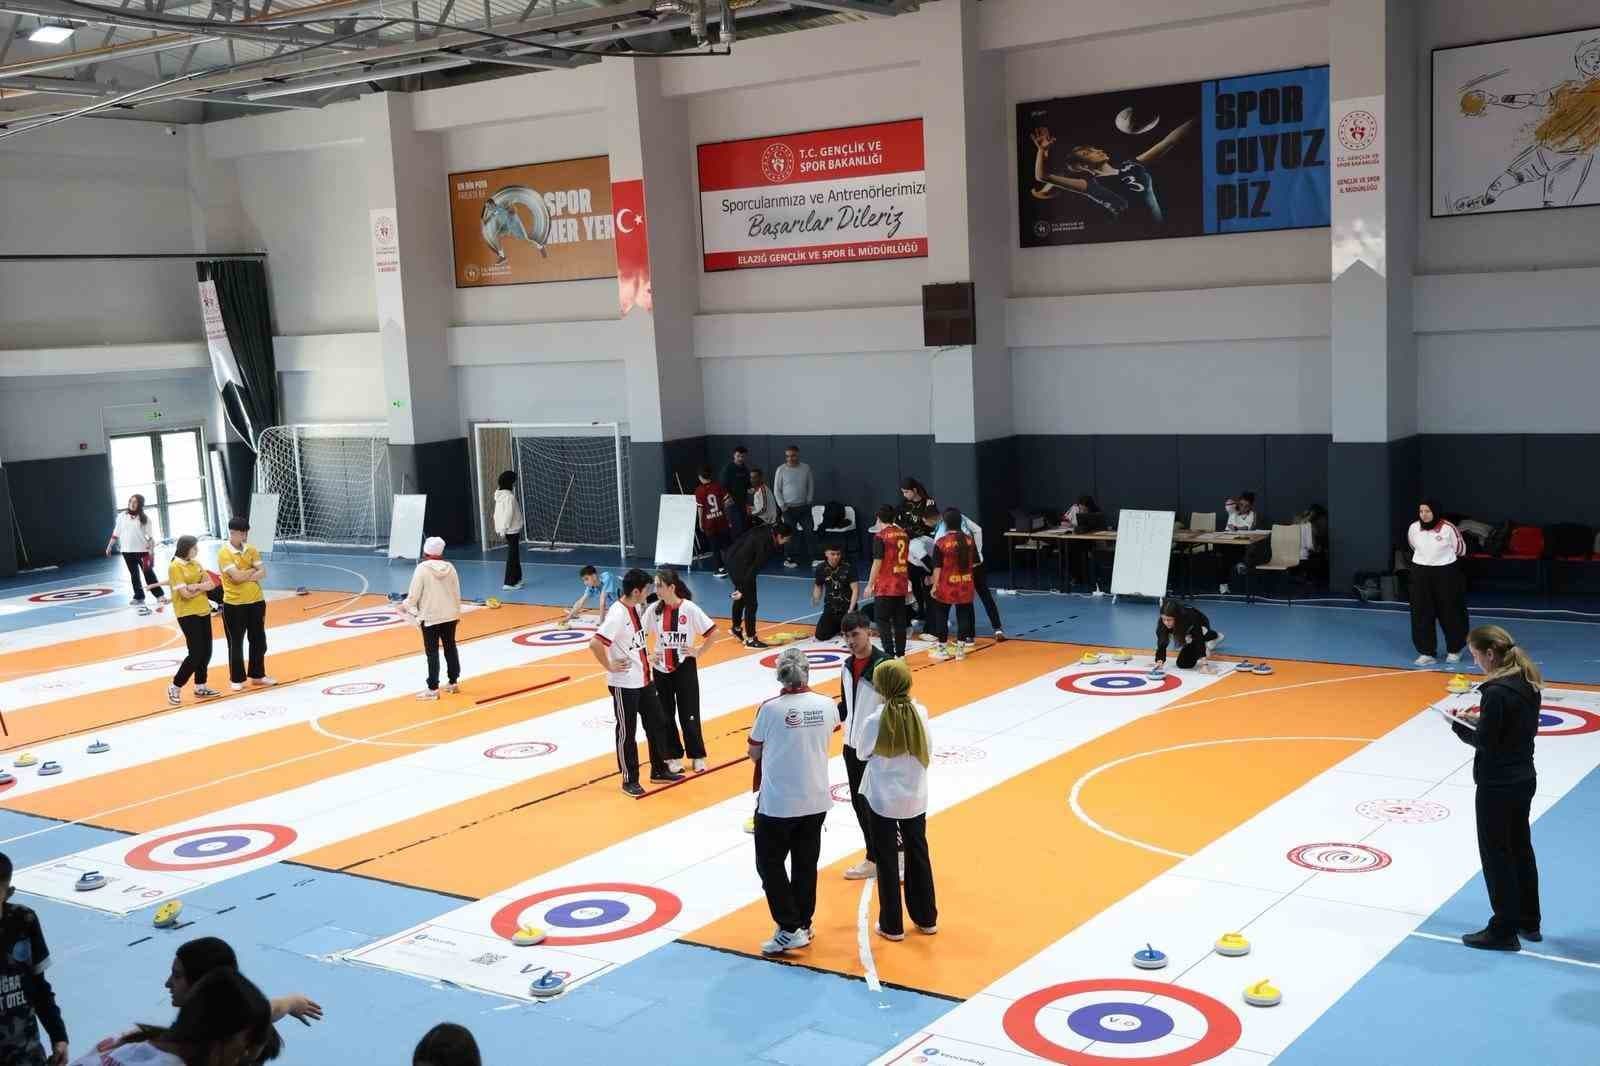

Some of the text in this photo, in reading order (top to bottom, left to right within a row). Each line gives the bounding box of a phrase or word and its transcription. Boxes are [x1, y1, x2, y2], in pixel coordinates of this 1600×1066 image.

[1215, 85, 1304, 130] SPOR
[799, 140, 881, 159] T.C. GENÇLİK VE
[1215, 129, 1326, 175] CUYUZ
[799, 154, 883, 173] SPOR BAKANLIĞI
[543, 188, 592, 217] SPOR
[721, 193, 806, 214] Sporcularımıza
[809, 193, 825, 204] ve
[1215, 178, 1271, 220] BİZ
[748, 204, 904, 240] Başarılar Dileriz
[738, 242, 919, 265] ELAZIĞ GENÇLİK VE SPOR İL MÜDÜRLÜĞÜ
[706, 493, 719, 513] 9
[896, 539, 907, 565] 2
